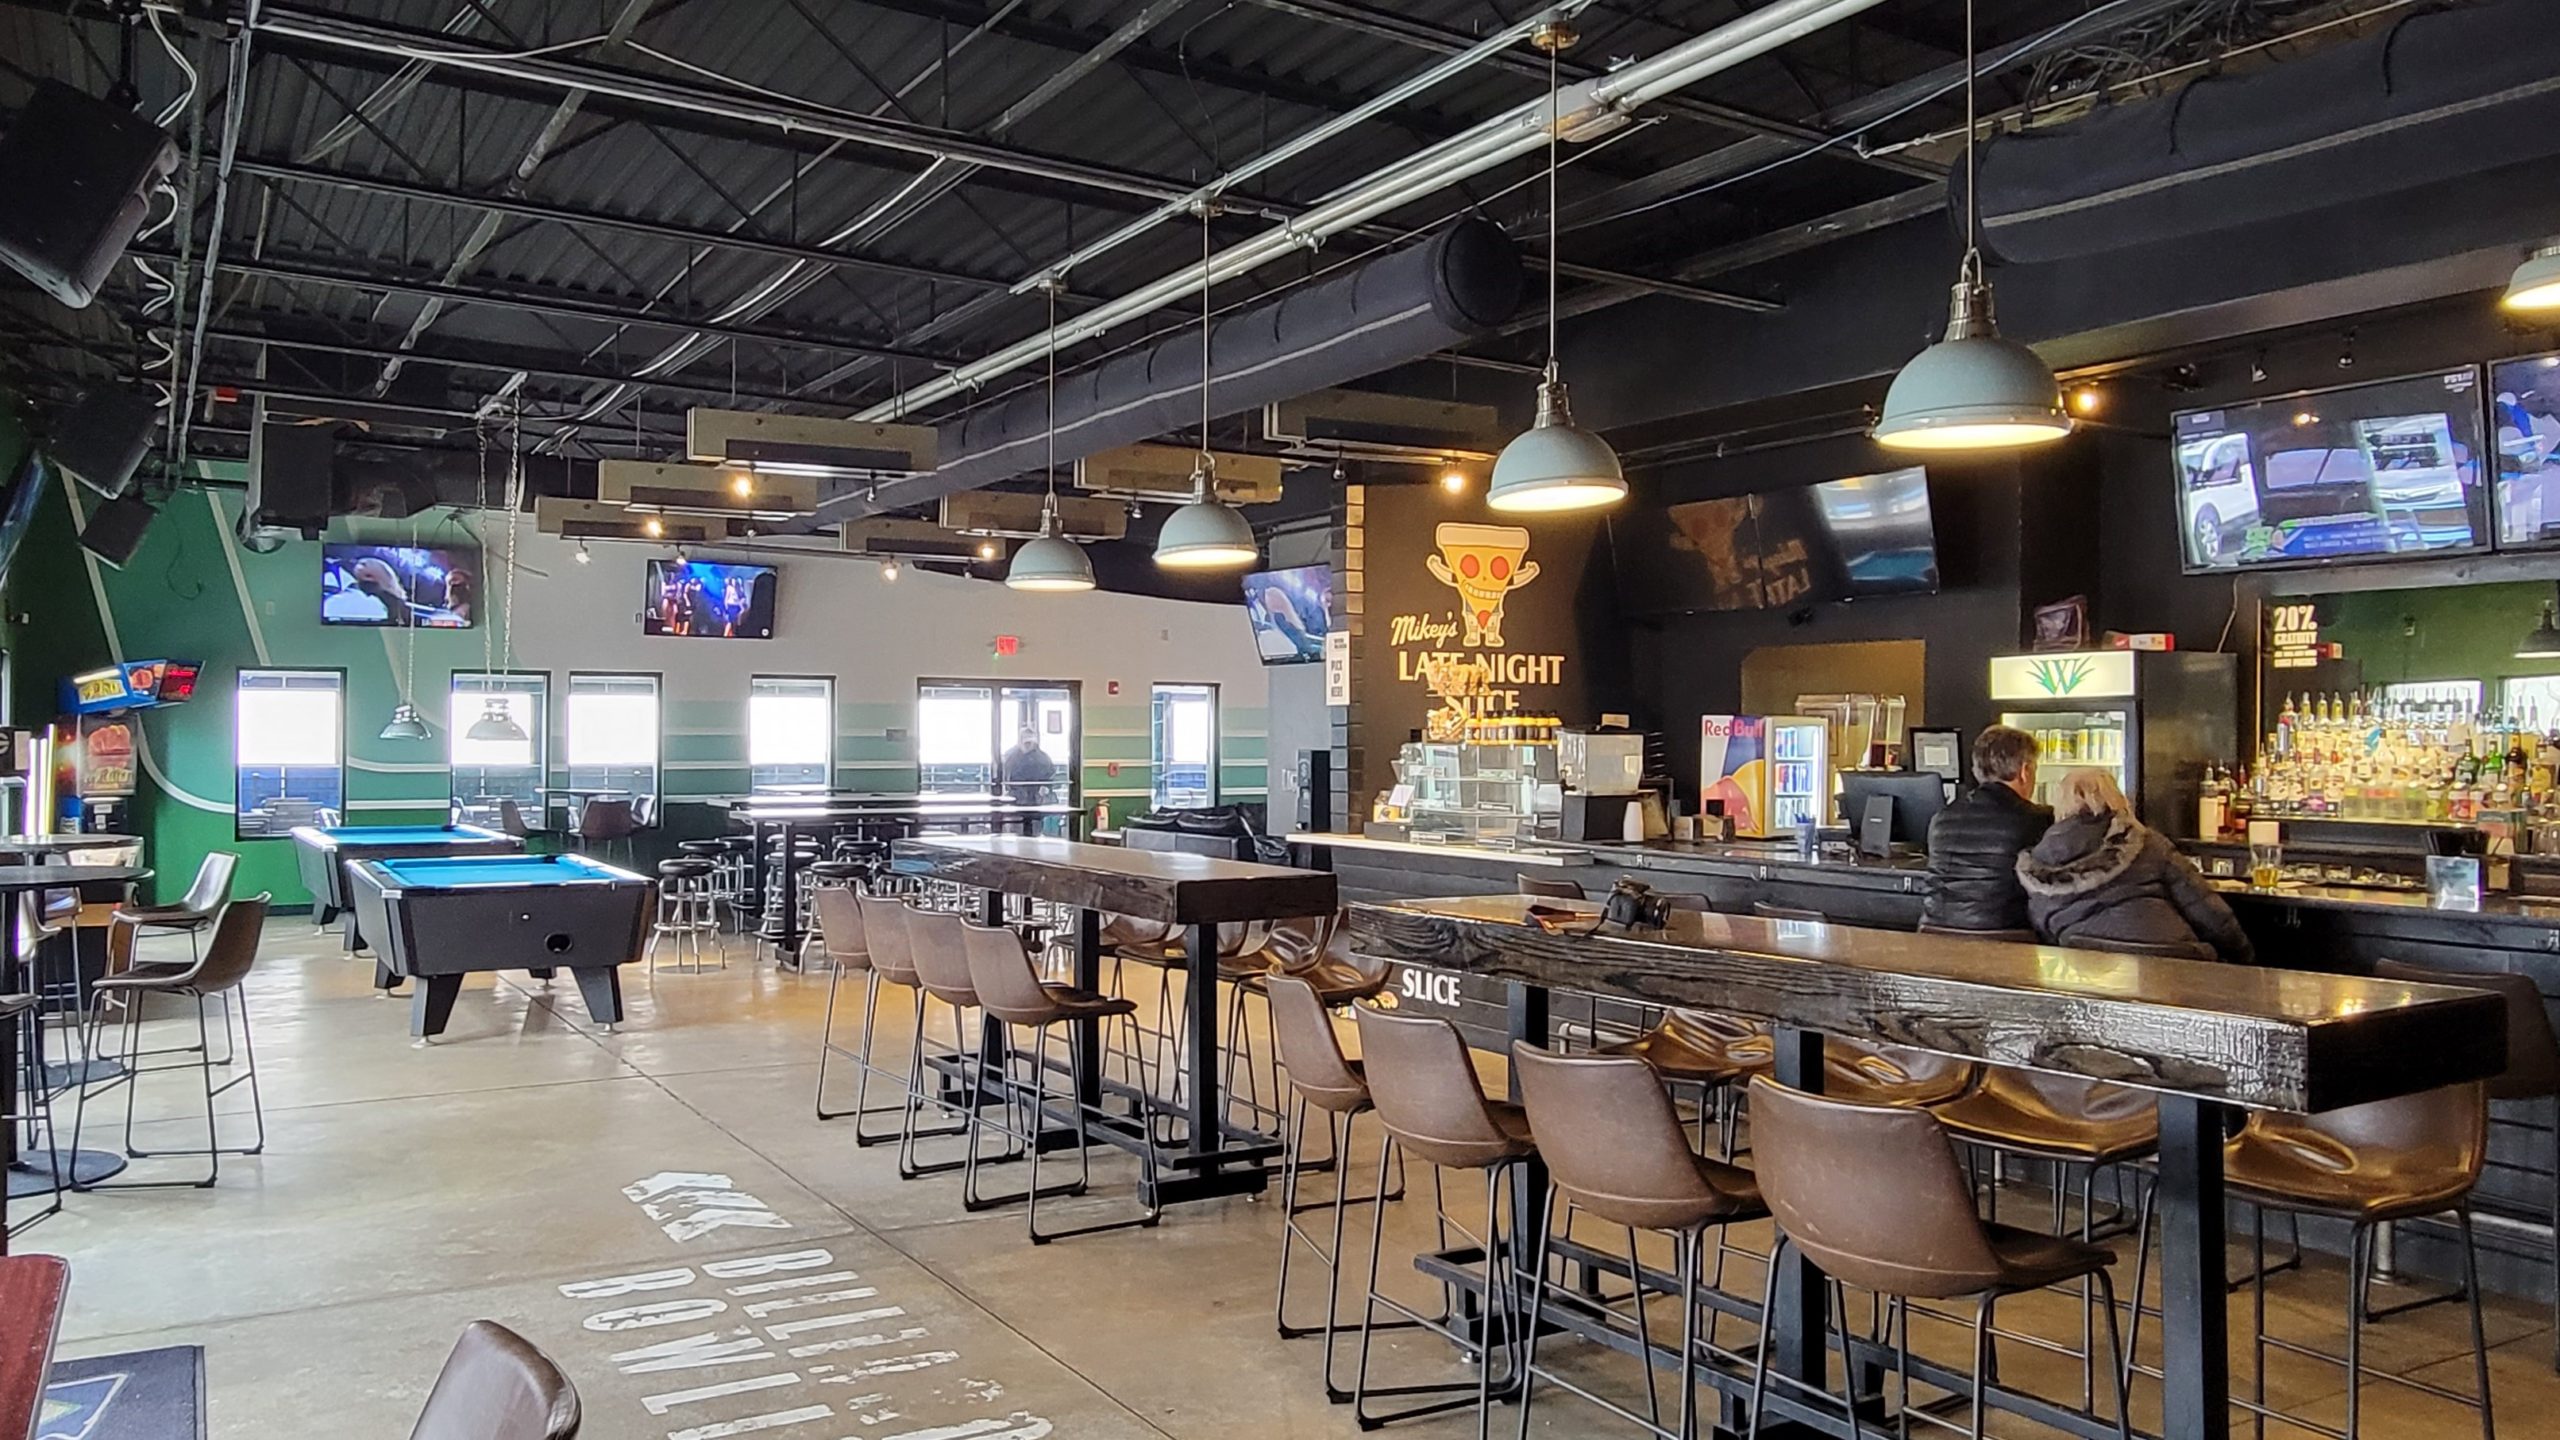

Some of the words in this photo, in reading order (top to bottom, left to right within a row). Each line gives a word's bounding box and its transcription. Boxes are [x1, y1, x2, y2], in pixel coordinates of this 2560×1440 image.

[1391, 611, 1458, 649] Mikey's
[2274, 605, 2318, 631] 20%
[1399, 651, 1465, 683] LA
[1704, 719, 1733, 736] Red
[1734, 718, 1764, 737] Bull
[1401, 968, 1461, 1007] SLICE
[557, 1267, 864, 1440] BOWLI
